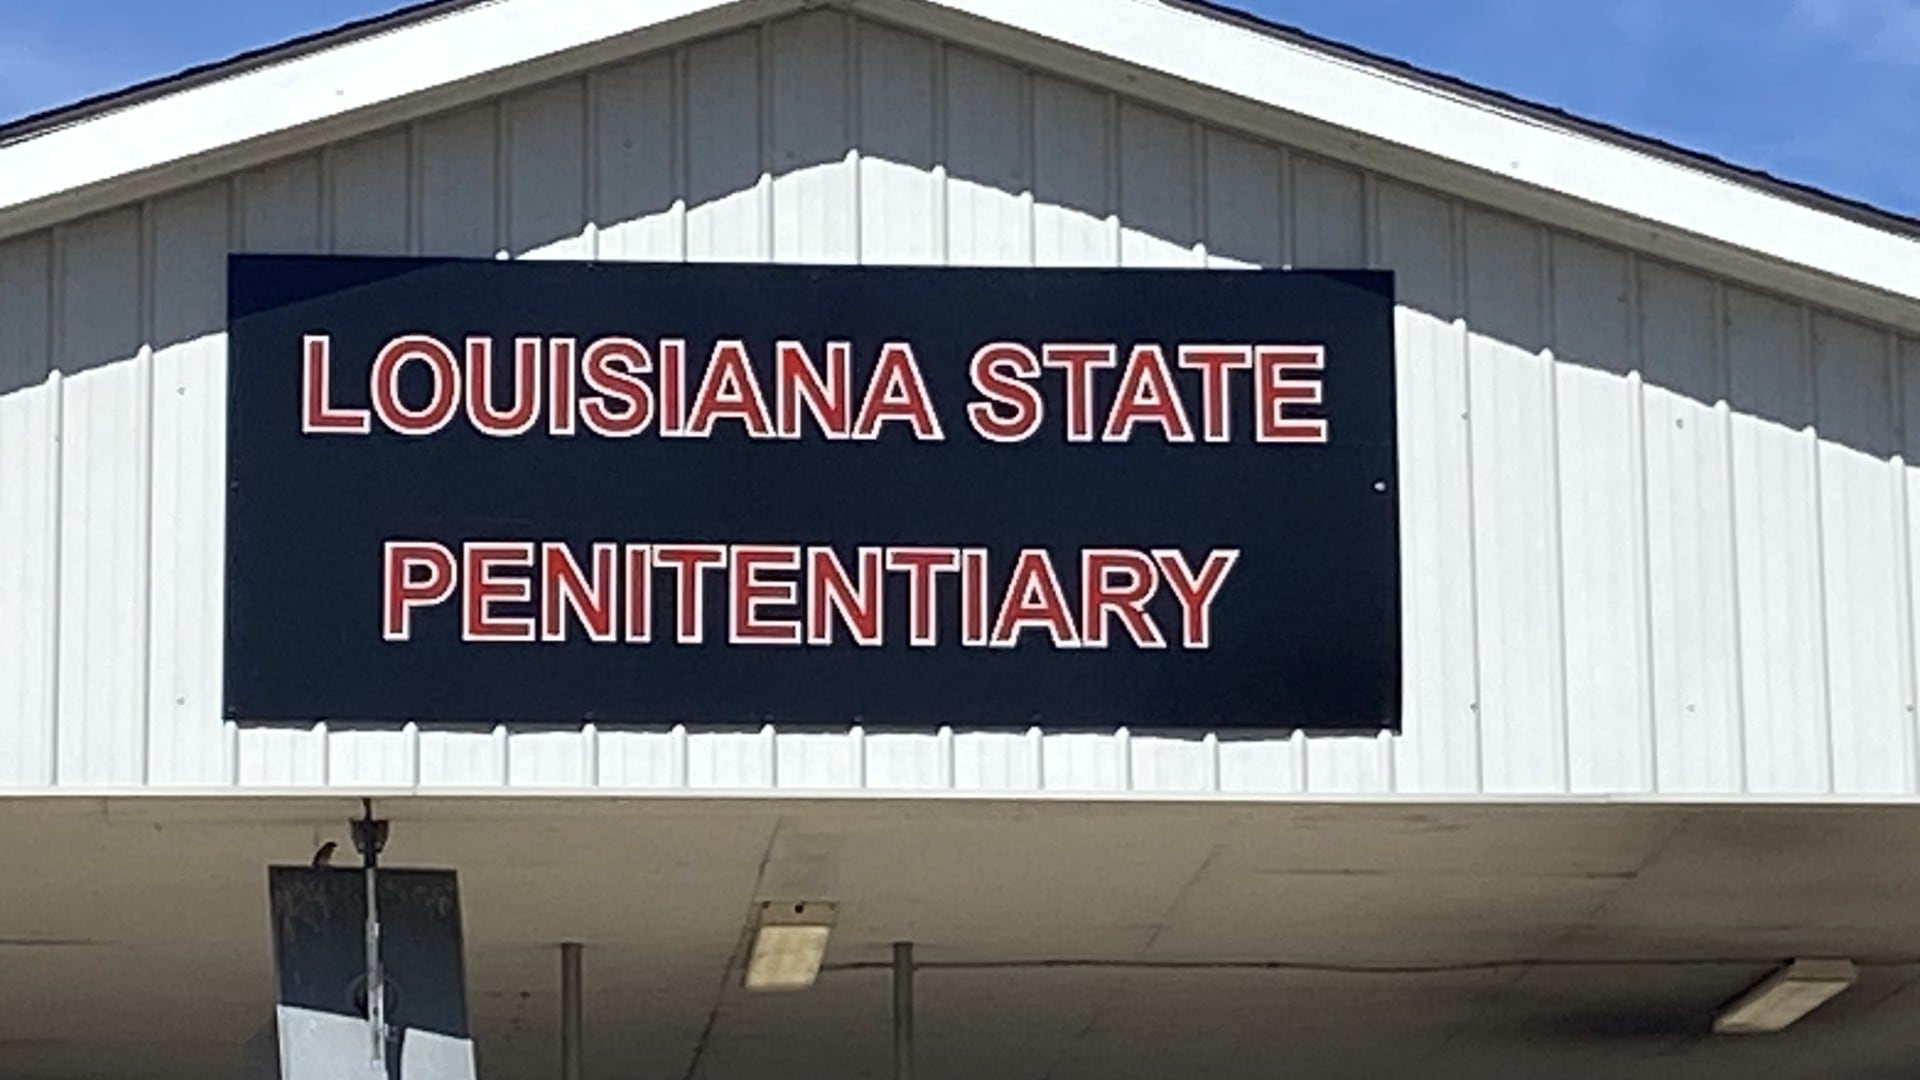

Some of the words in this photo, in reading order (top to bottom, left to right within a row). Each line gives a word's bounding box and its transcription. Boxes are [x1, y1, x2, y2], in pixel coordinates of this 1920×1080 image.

[302, 334, 945, 442] LOUISIANA
[967, 341, 1329, 443] STATE
[382, 541, 1240, 649] PENITENTIARY
